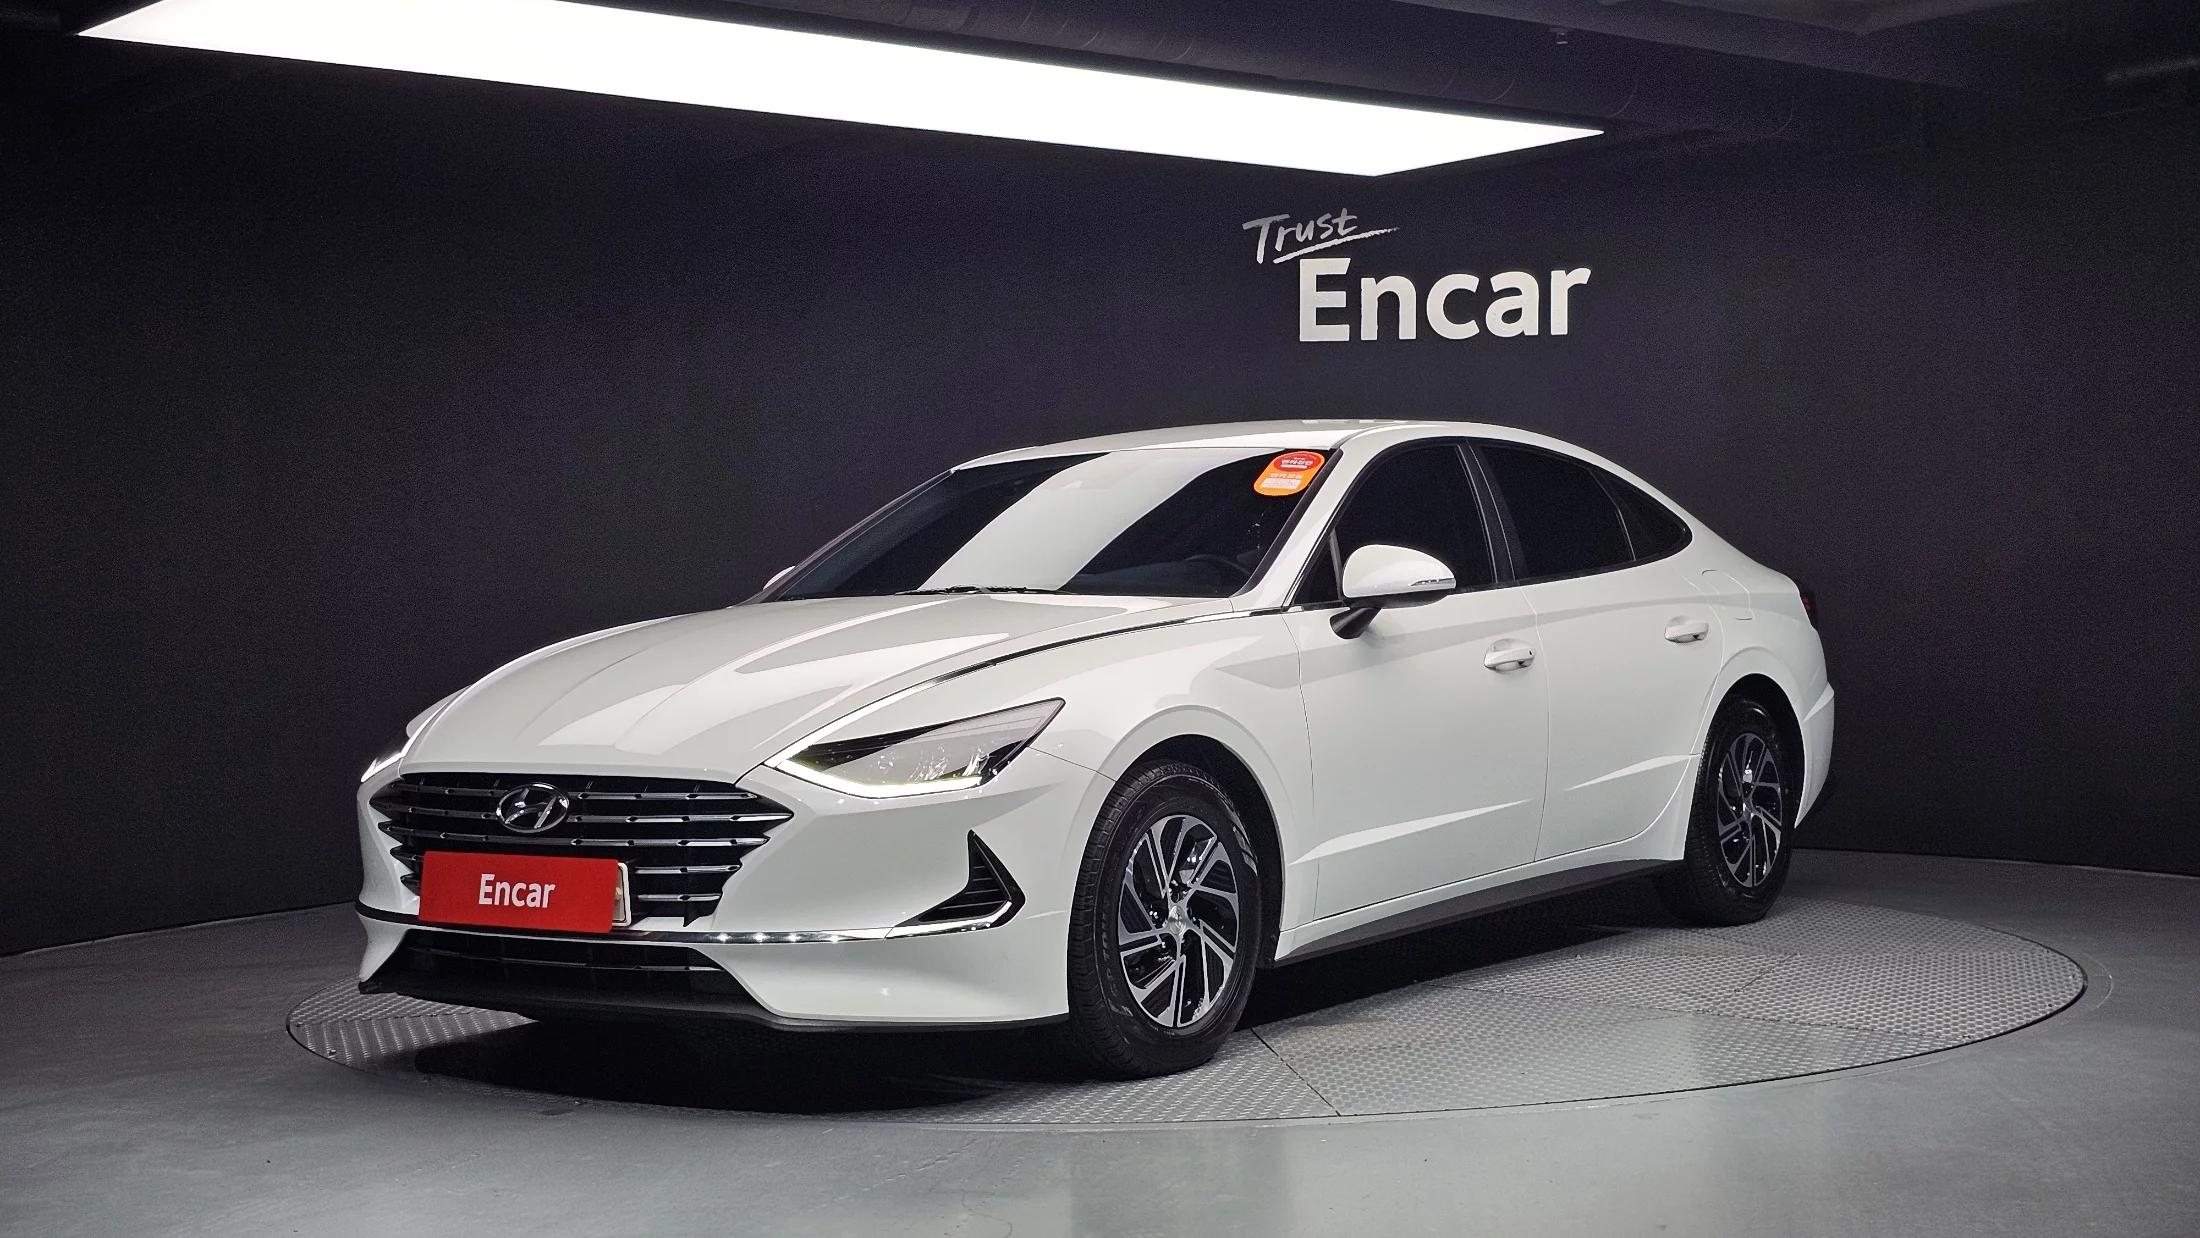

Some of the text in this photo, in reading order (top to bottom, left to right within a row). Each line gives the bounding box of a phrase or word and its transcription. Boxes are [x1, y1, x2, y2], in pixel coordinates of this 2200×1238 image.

[1242, 207, 1358, 264] Trust
[1299, 257, 1592, 342] Encar
[478, 873, 556, 909] Encar
